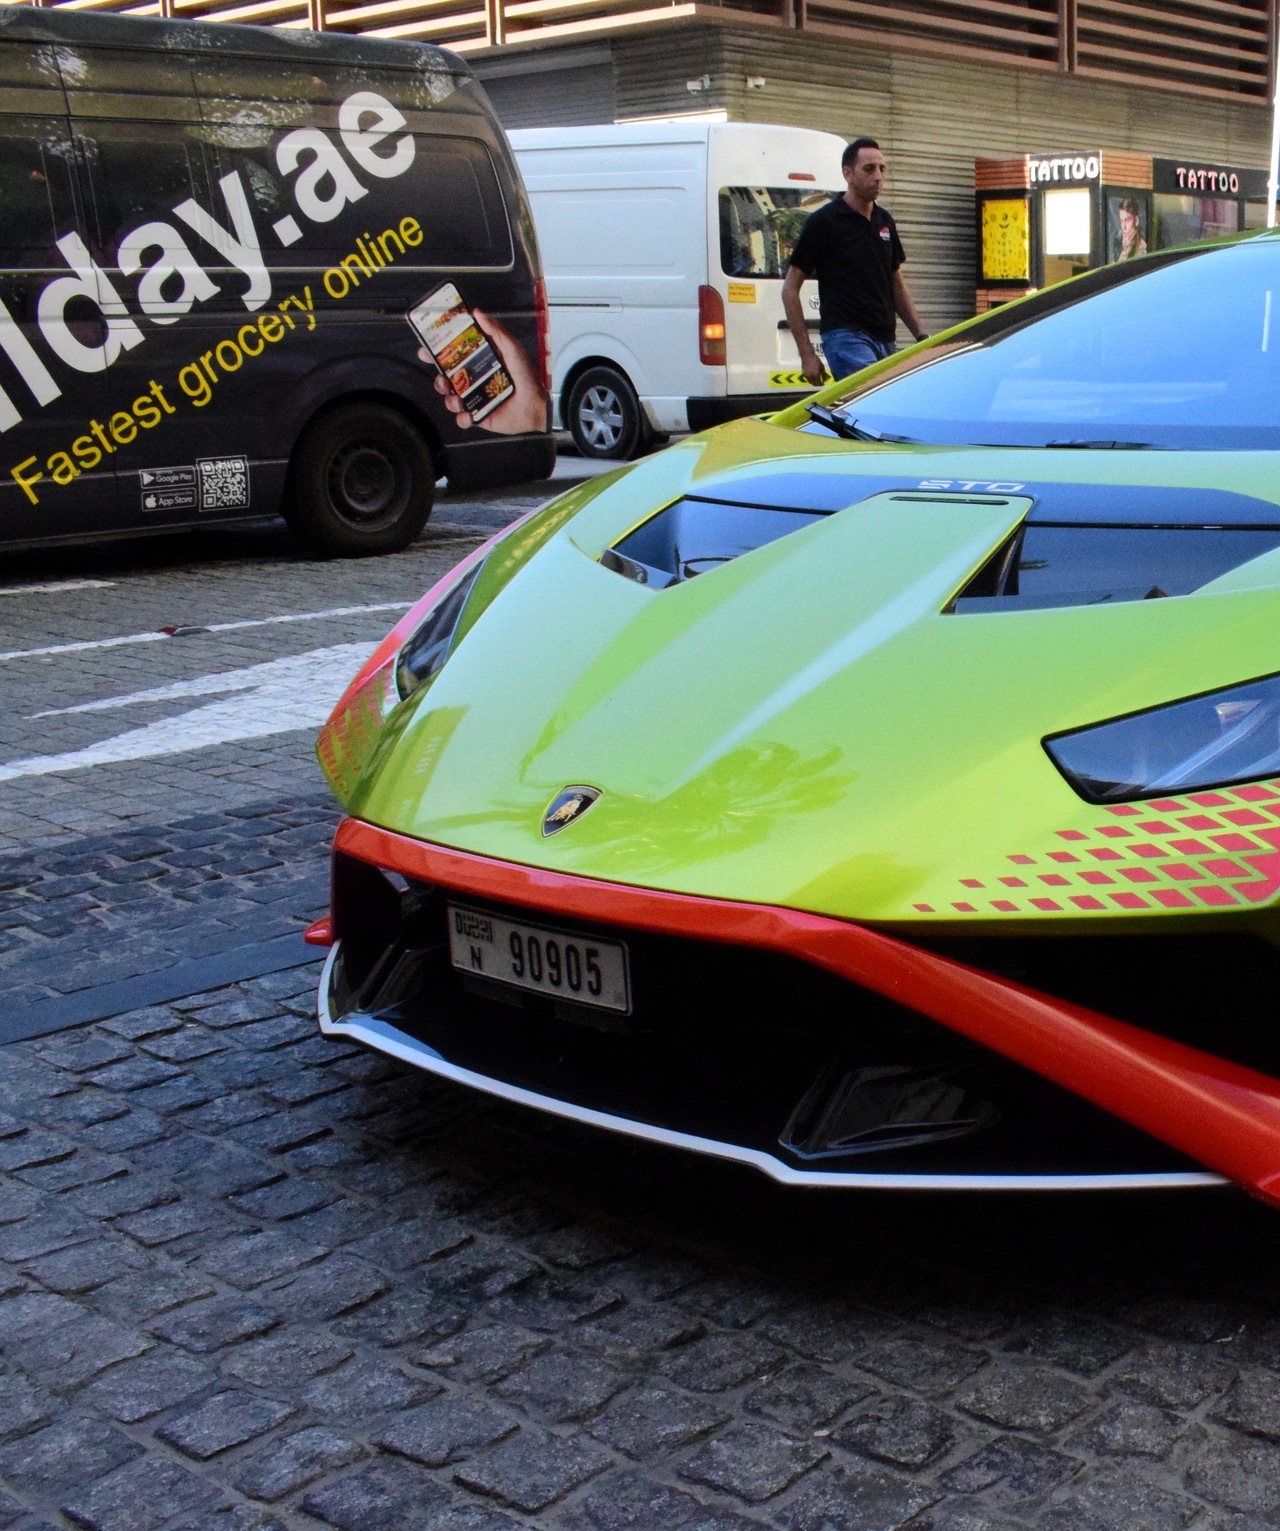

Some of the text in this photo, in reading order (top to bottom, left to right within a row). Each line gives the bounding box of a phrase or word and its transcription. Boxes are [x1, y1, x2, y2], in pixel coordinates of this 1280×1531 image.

[1029, 156, 1100, 182] TATTOO
[1176, 167, 1239, 193] TATTOO
[11, 215, 424, 506] Fastest grocery online
[156, 473, 193, 483] Google Play
[918, 479, 1026, 492] STO
[158, 496, 193, 507] App Store
[470, 930, 602, 996] N 90905
